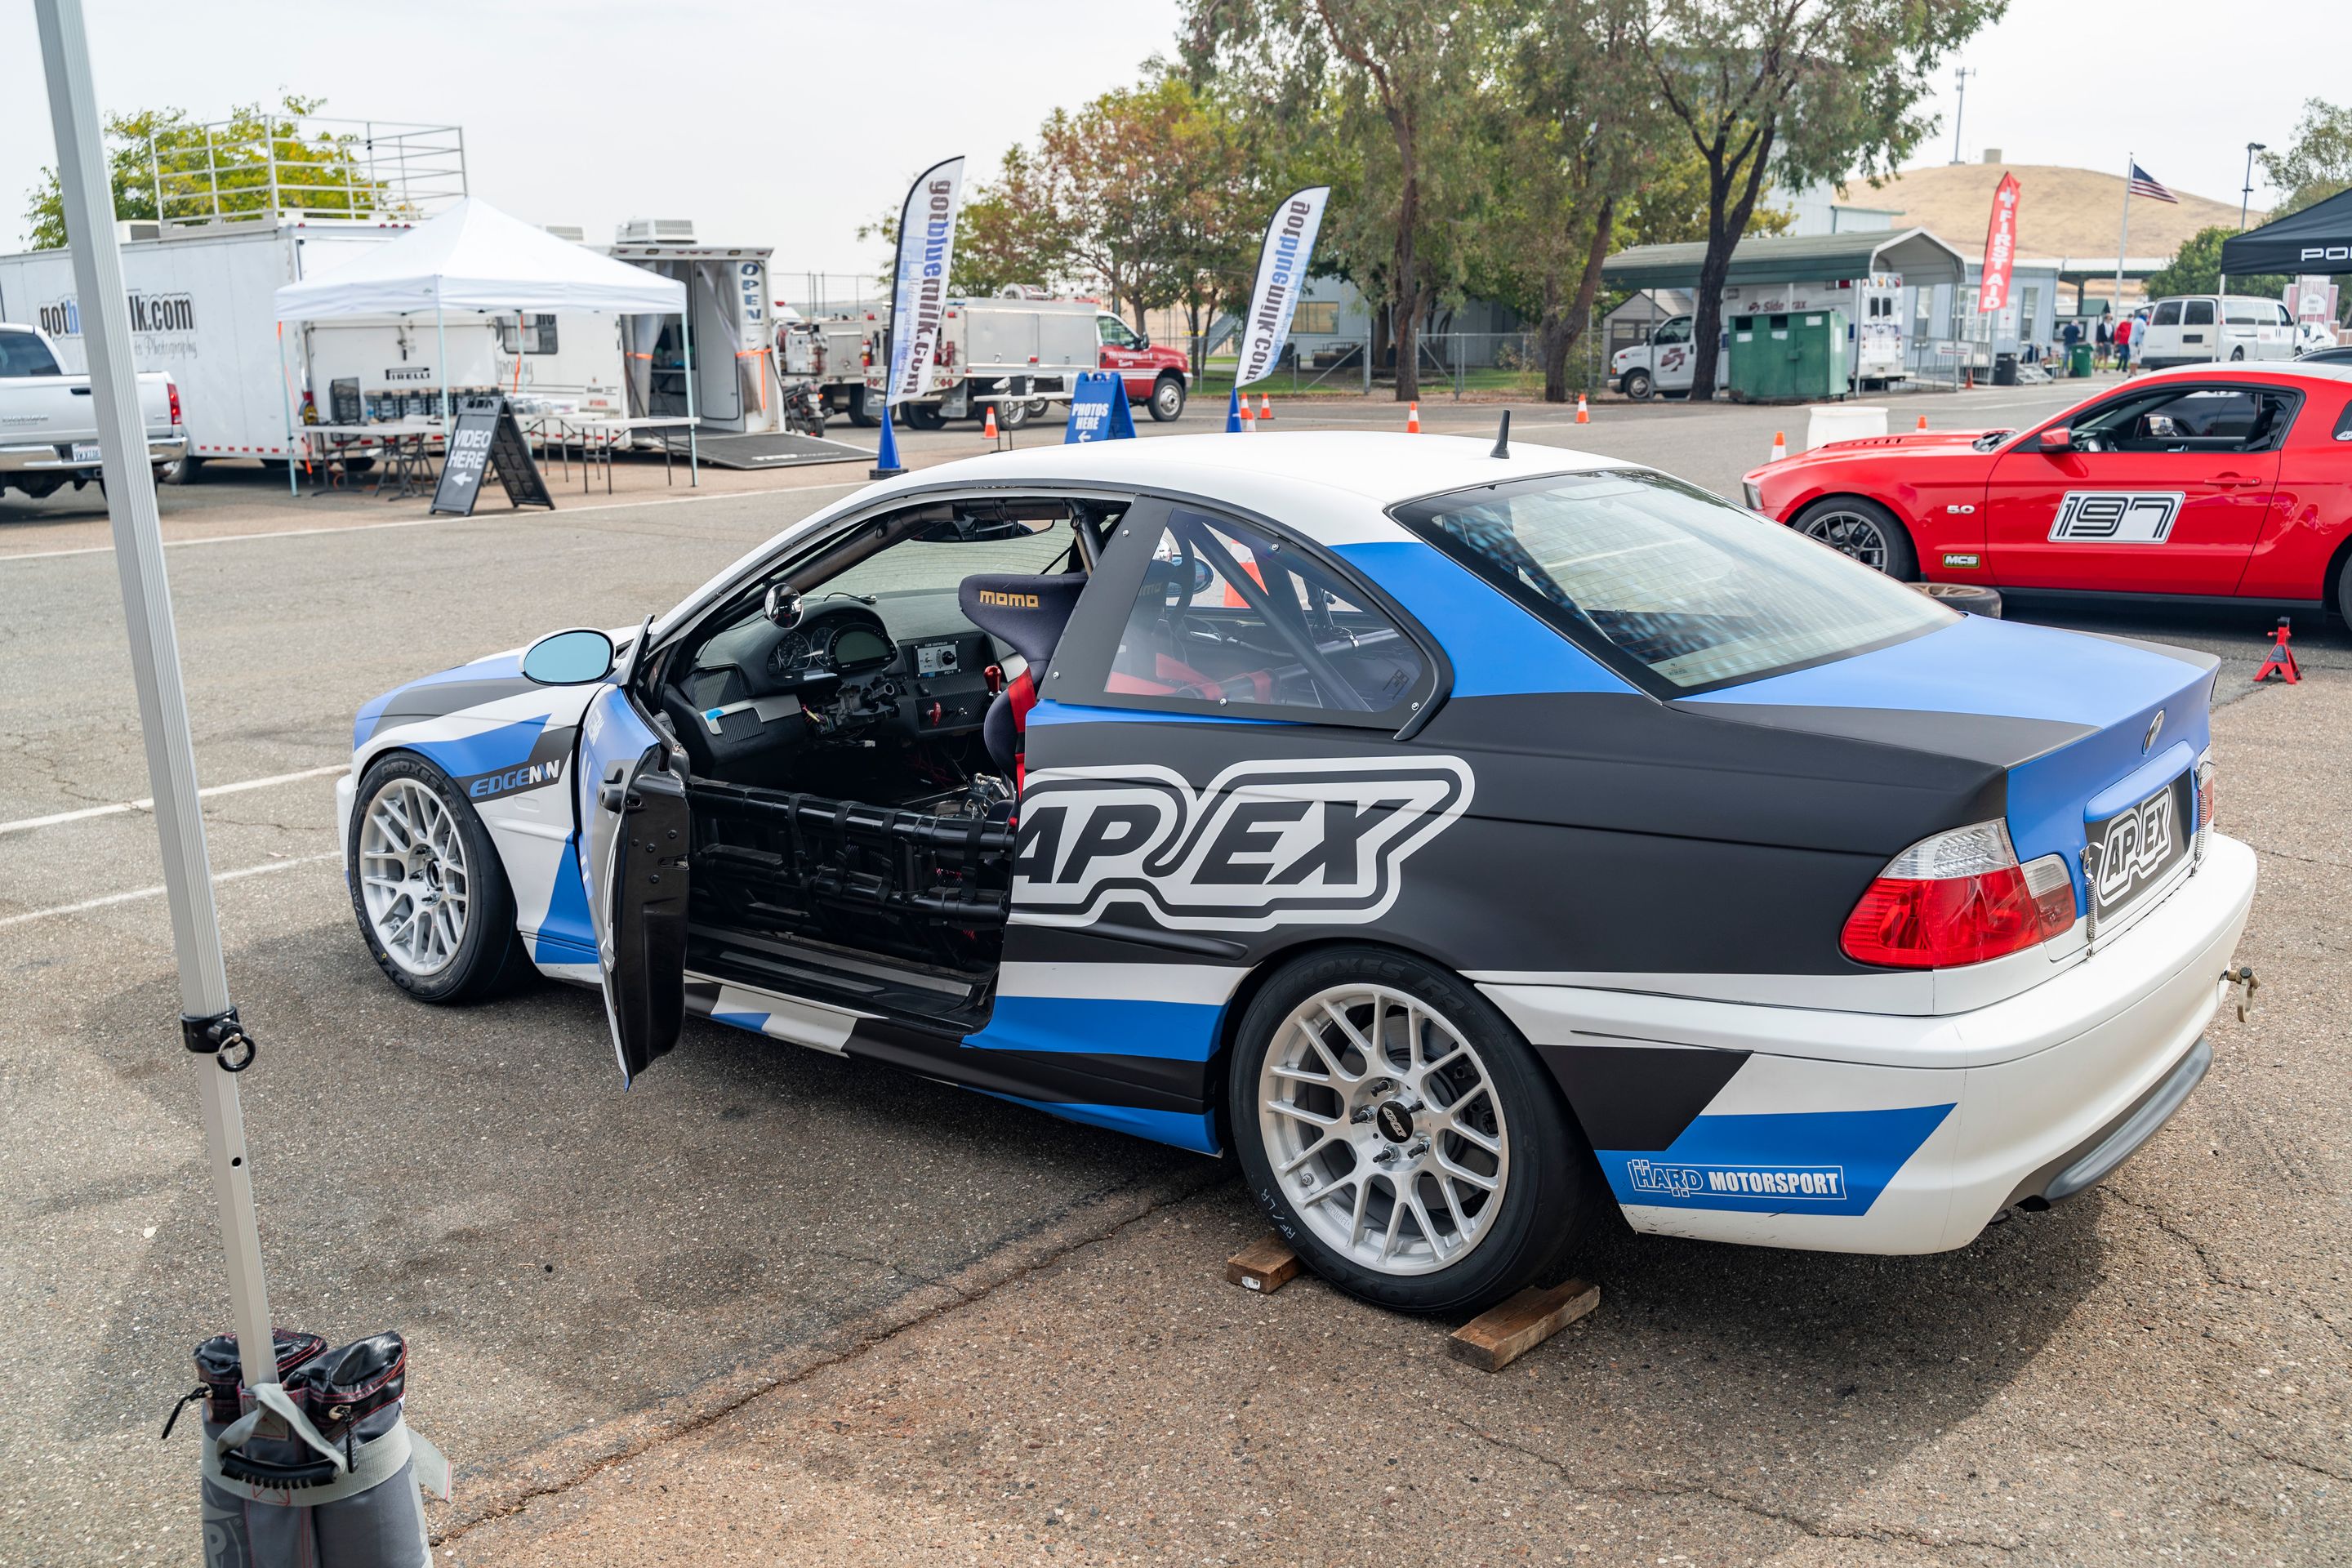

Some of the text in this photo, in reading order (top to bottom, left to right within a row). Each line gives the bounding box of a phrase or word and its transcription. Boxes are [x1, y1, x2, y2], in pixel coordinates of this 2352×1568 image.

[1983, 209, 2012, 310] FIRST AID
[2301, 246, 2352, 261] PO
[741, 263, 761, 320] OPEN
[902, 179, 951, 394] gotbluemilk.com
[40, 295, 194, 338] gotblk.com
[385, 368, 430, 380] PIRELLI
[1071, 403, 1109, 416] PHOTOS
[1075, 417, 1099, 430] HERE
[453, 429, 492, 448] VIDEO
[448, 450, 487, 470] HERE
[2056, 497, 2176, 538] 197
[1944, 555, 1978, 564] MCS
[381, 760, 441, 791] PROXES
[1013, 798, 1416, 885] APEX
[2105, 802, 2167, 884] APEX
[1708, 1170, 1838, 1195] MOTORSPORT
